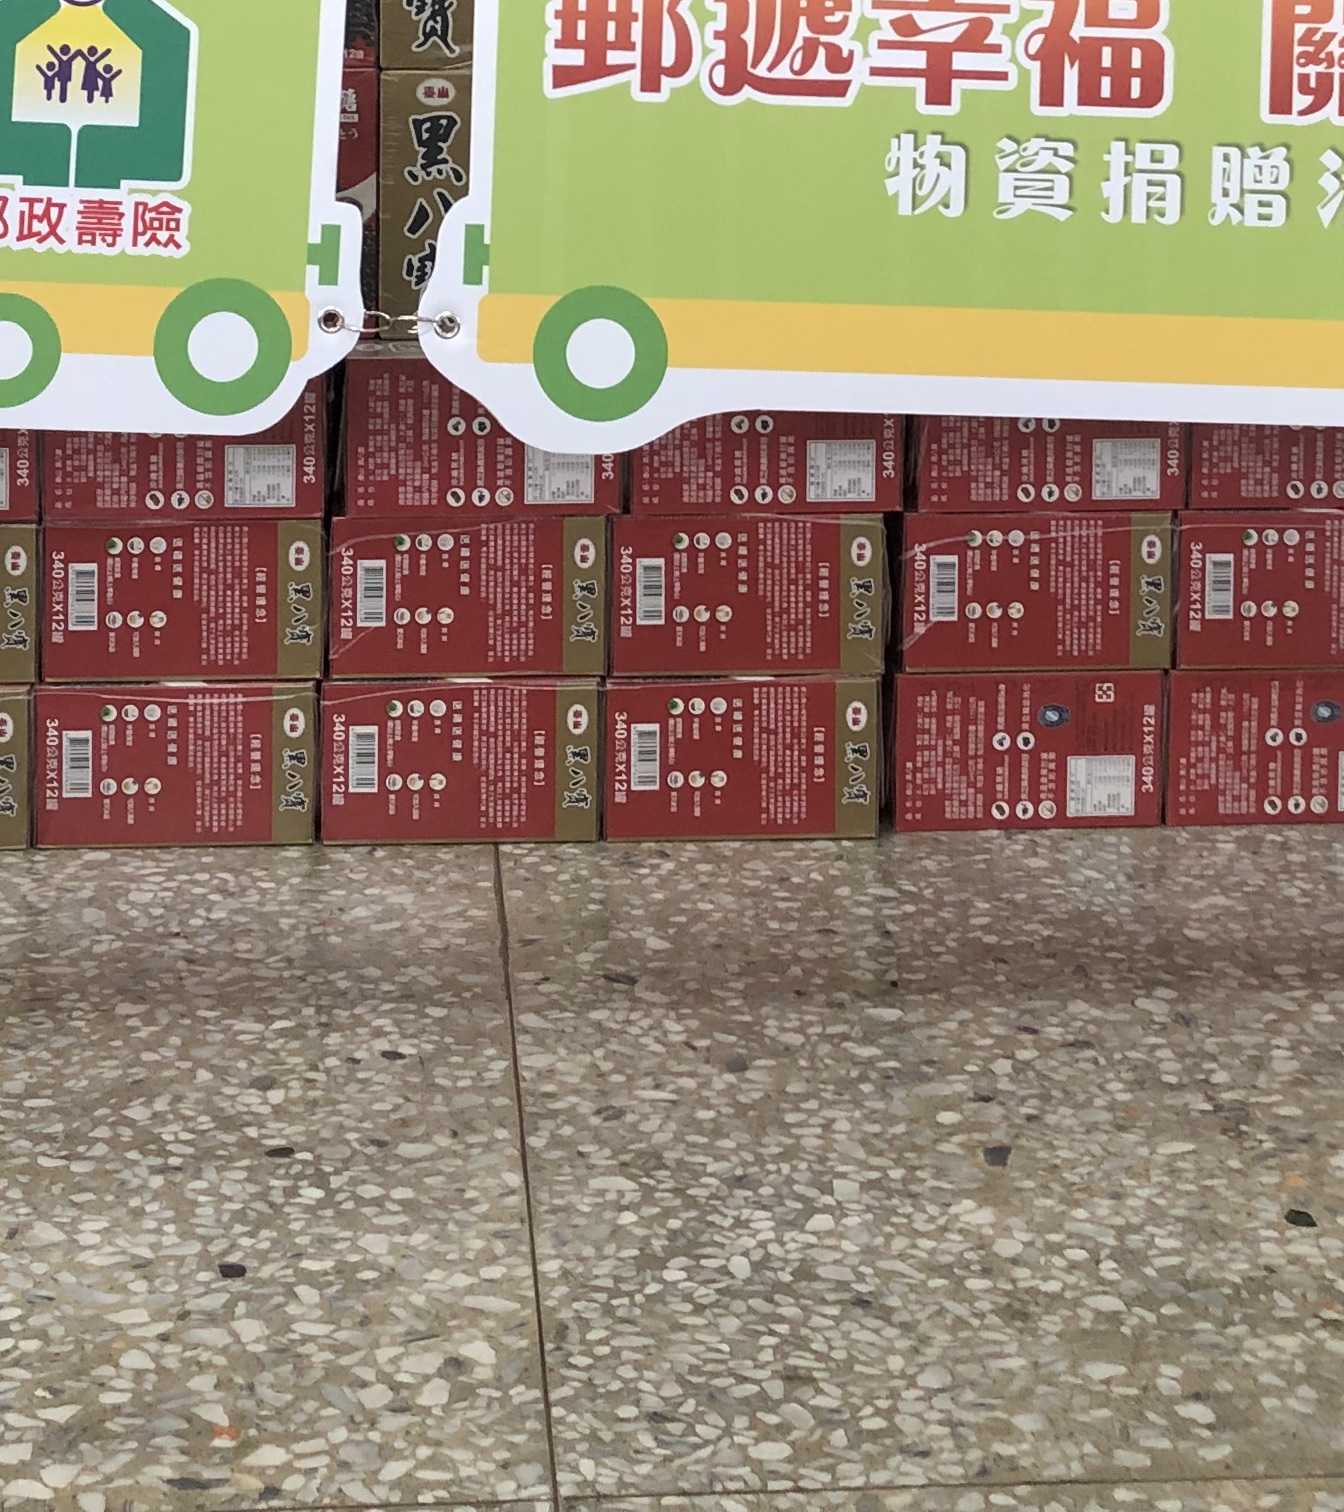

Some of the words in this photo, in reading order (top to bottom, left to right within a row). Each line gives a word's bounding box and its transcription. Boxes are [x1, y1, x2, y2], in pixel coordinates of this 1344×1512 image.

[0, 586, 31, 651] 黑八寶
[283, 582, 313, 645] 黑八寶
[570, 578, 598, 643] 黑八寶
[847, 577, 876, 640] 黑八寶
[1135, 574, 1165, 637] 黑八寶
[278, 748, 309, 812] 黑八寶
[561, 745, 592, 810] 黑八寶
[841, 741, 871, 806] 黑八寶
